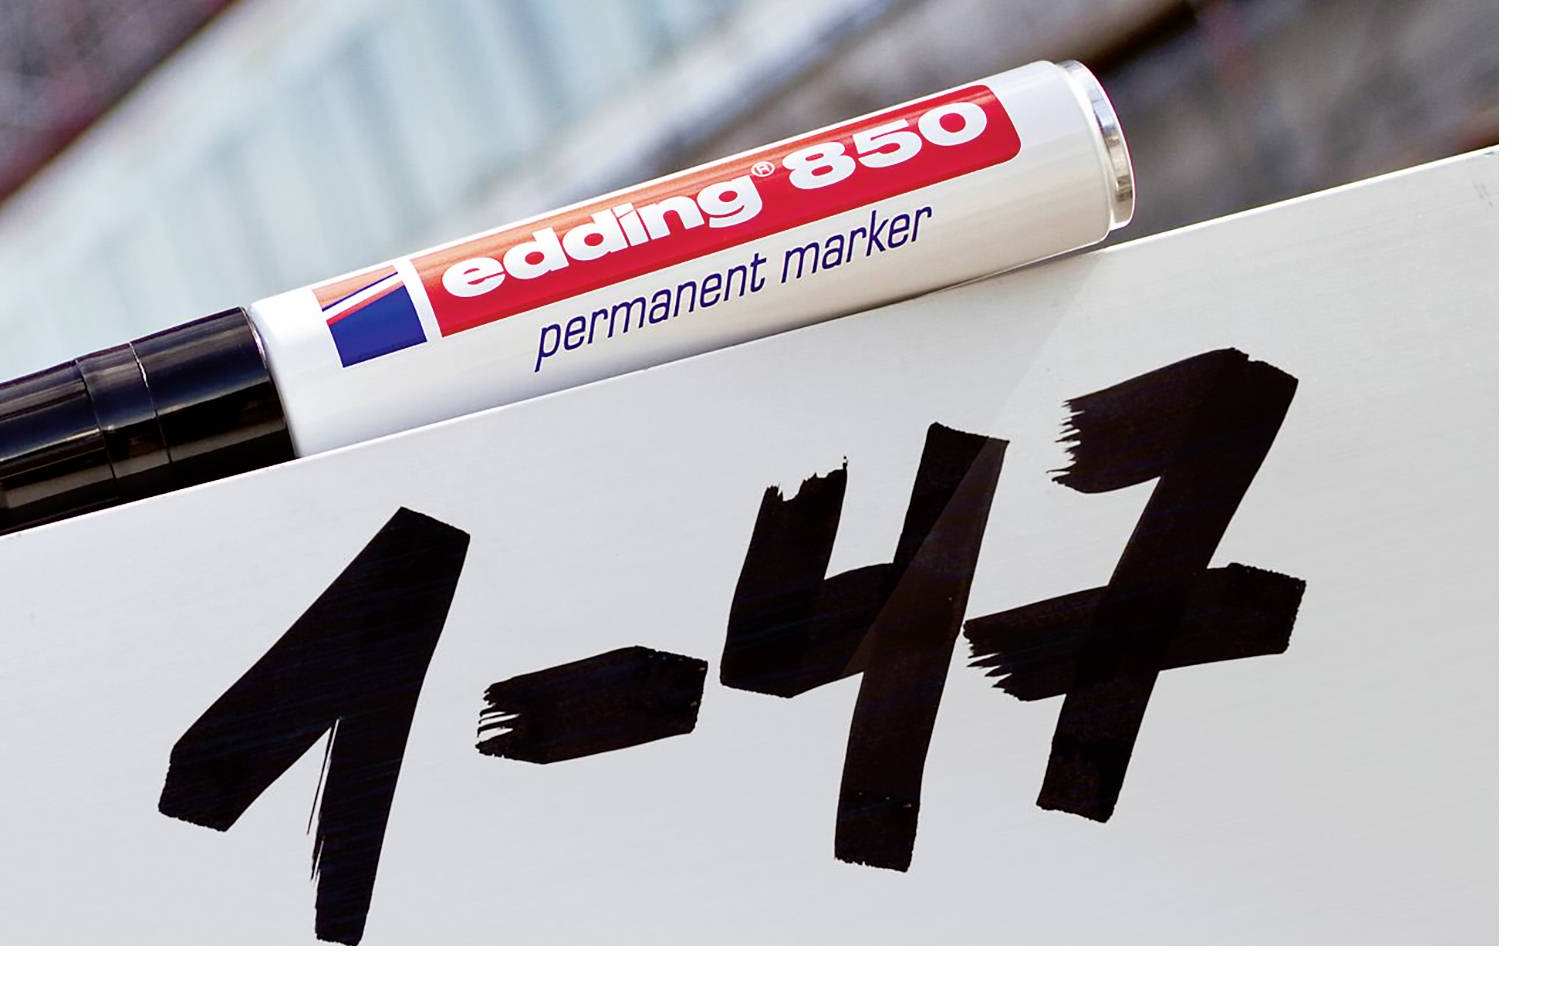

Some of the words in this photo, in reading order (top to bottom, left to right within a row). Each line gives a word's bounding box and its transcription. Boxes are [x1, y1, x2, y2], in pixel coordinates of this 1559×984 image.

[784, 102, 987, 190] 850
[535, 253, 767, 371] permanent
[781, 205, 933, 283] marker
